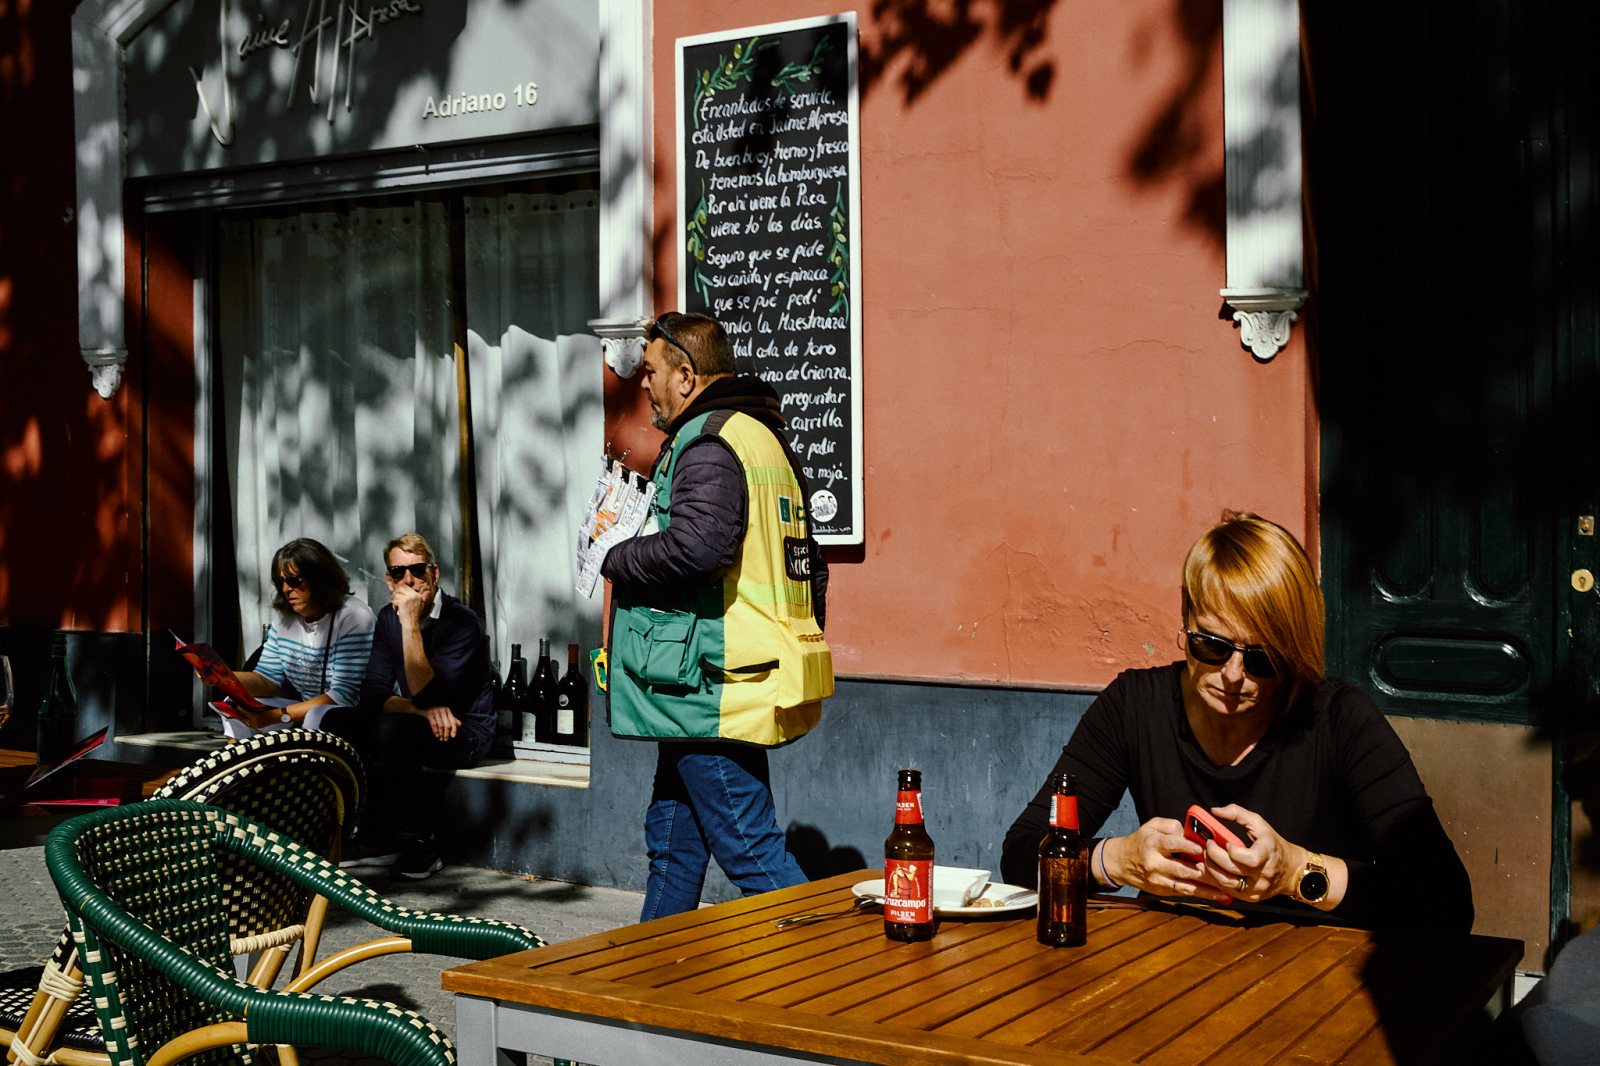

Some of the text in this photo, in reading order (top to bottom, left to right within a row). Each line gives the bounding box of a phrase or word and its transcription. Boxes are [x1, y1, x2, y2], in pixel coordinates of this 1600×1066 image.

[422, 81, 538, 119] Adriano 16
[700, 93, 771, 121] Encantados
[773, 90, 786, 109] de
[749, 122, 764, 136] en
[769, 114, 807, 135] Jaime
[695, 150, 710, 169] De
[714, 148, 740, 167] buen
[774, 140, 807, 160] tierno
[808, 147, 816, 162] y
[710, 163, 847, 190] tenemos la hamburguesa
[707, 193, 726, 214] Por
[749, 194, 778, 211] viene
[780, 186, 790, 207] la
[797, 183, 827, 206] Paca
[711, 221, 741, 238] viene
[767, 212, 783, 233] los
[707, 239, 825, 269] Seguro que se pide
[712, 267, 829, 291] su cañita y espinaca
[714, 297, 733, 317] que
[737, 295, 750, 309] se
[758, 311, 772, 333] la
[778, 308, 846, 332] Maestranza
[756, 339, 779, 358] cola
[784, 340, 798, 356] de
[804, 337, 836, 356] toro
[786, 363, 799, 381] de
[781, 386, 846, 413] preguntar
[791, 407, 844, 431] carrilla
